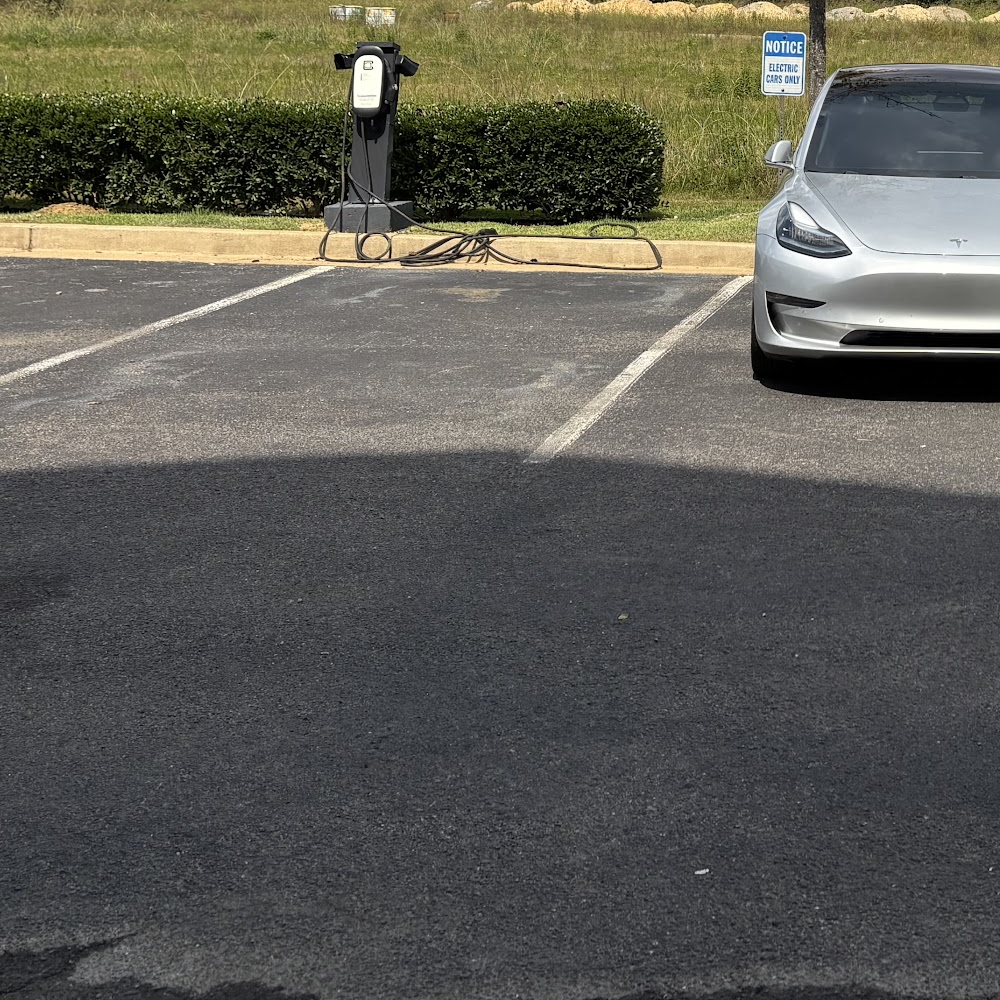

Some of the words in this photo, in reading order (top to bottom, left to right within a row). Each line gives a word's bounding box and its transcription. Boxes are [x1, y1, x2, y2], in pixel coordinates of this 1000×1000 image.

[766, 40, 803, 54] NOTICE
[769, 63, 799, 73] ELECTRIC
[766, 74, 783, 84] CARS
[784, 75, 801, 84] ONLY
